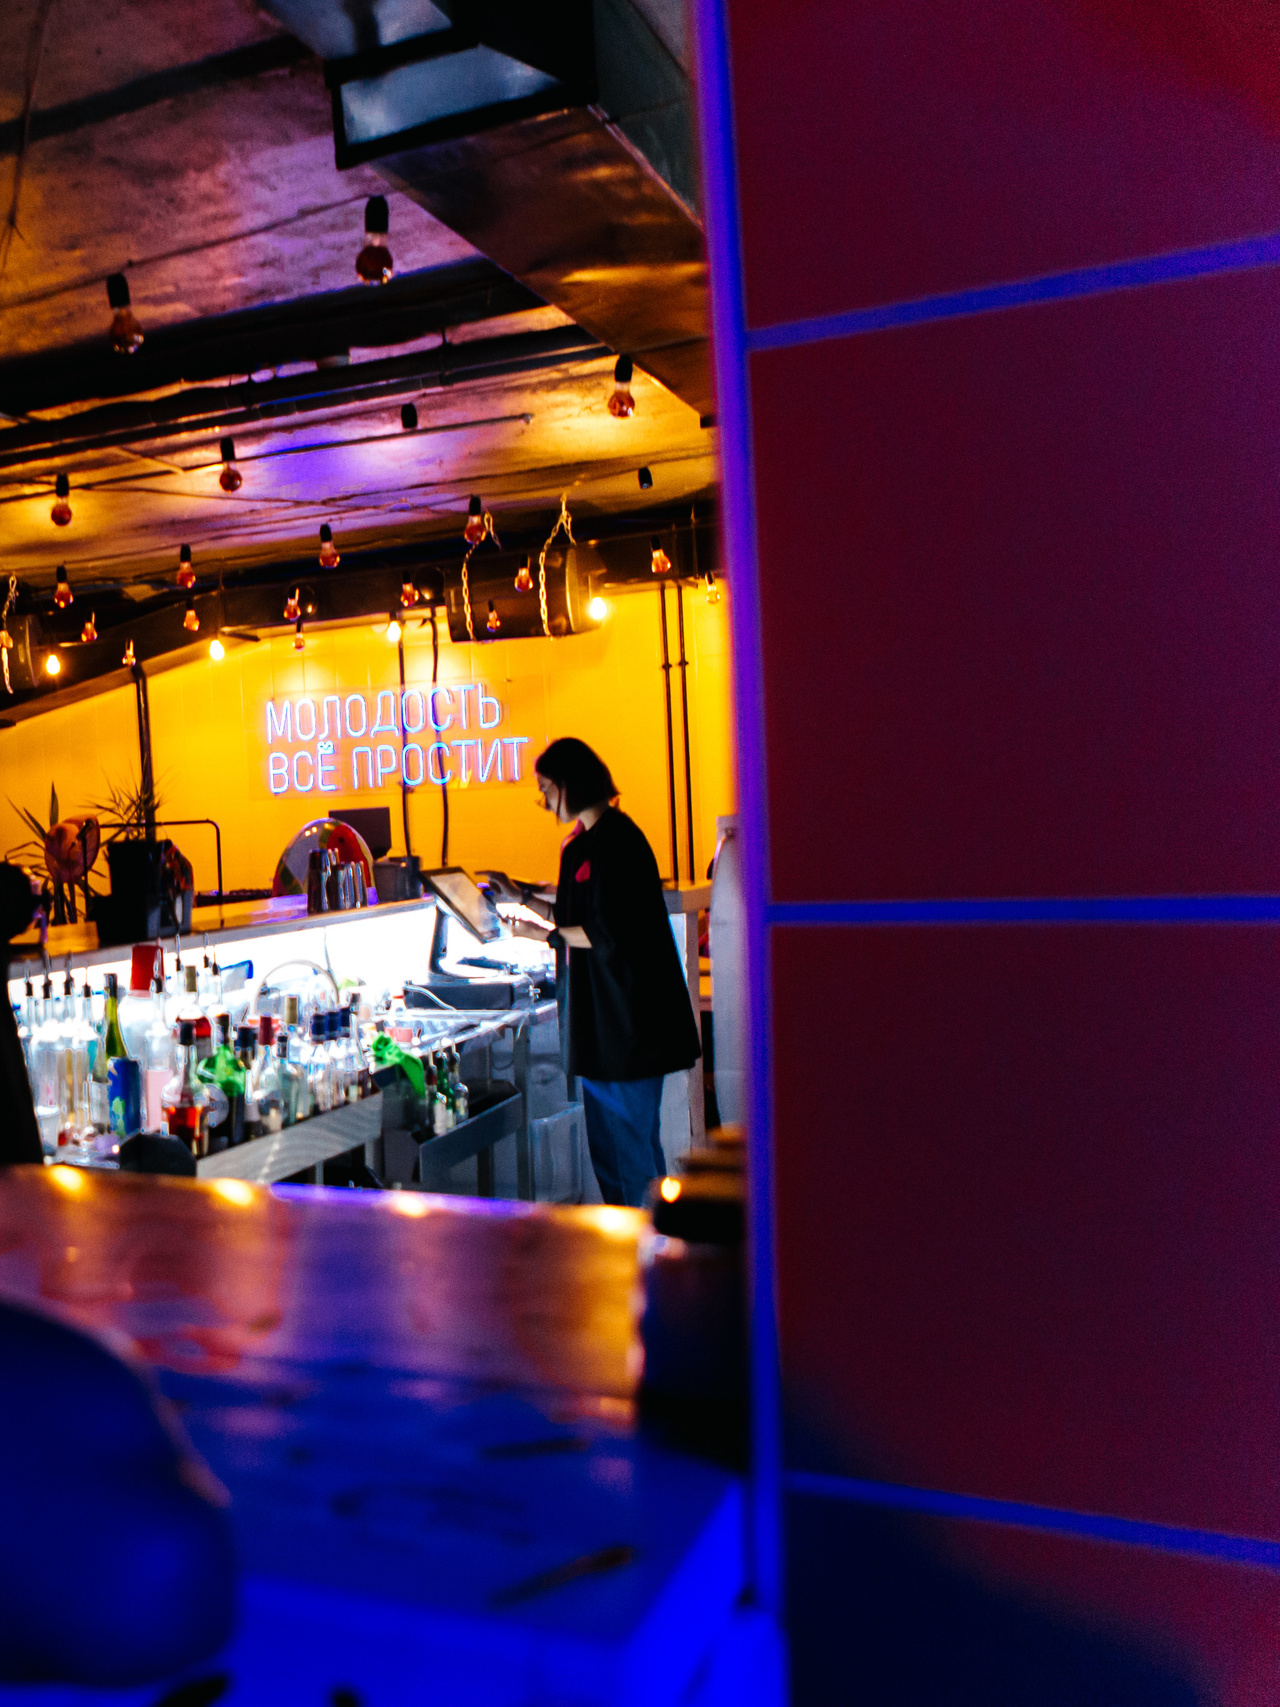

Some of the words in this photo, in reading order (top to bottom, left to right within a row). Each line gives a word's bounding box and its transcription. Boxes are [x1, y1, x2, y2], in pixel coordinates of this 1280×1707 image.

[265, 683, 500, 743] МОЛОДОСТЬ
[268, 741, 338, 794] ВСЁ
[352, 737, 529, 789] ПРОСТИТ
